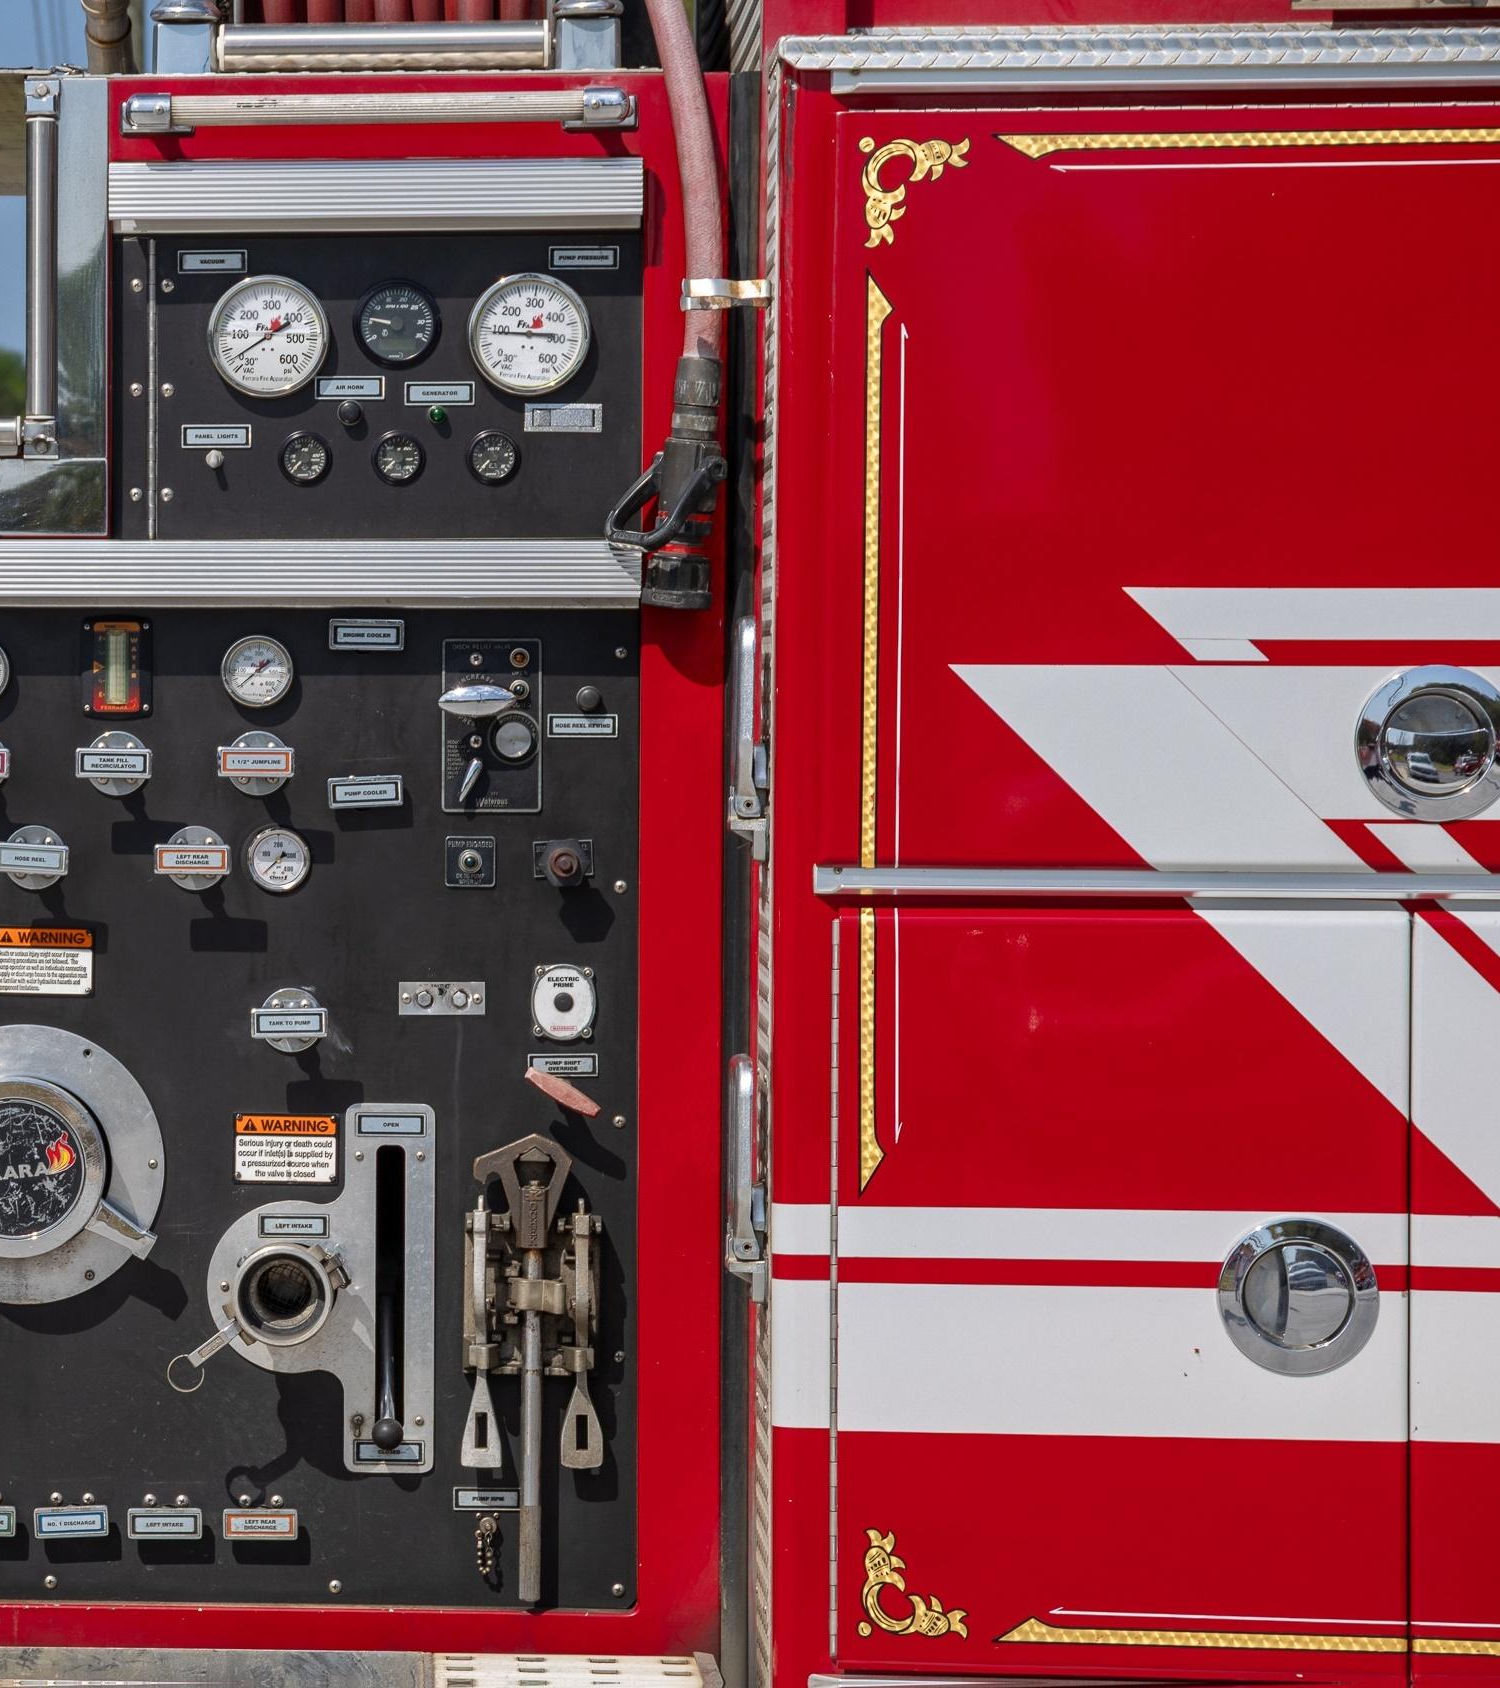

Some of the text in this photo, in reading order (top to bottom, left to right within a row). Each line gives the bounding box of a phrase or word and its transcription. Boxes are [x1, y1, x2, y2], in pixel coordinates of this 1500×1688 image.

[262, 300, 282, 310] 300
[525, 297, 545, 309] 300
[239, 310, 259, 320] 200
[501, 306, 521, 317] 200
[283, 312, 303, 323] 400
[545, 312, 565, 323] 400
[231, 330, 249, 340] 100
[492, 325, 510, 335] 100
[285, 334, 305, 344] 500
[279, 354, 299, 365] 600
[538, 353, 558, 364] 600
[283, 367, 292, 375] psi
[17, 931, 86, 944] WARNING
[260, 1119, 329, 1132] WARNING
[238, 1138, 264, 1147] Serious
[265, 1139, 283, 1149] injury
[293, 1140, 313, 1148] death
[313, 1140, 333, 1148] could
[258, 1149, 264, 1157] if
[264, 1149, 286, 1158] inlet(s)
[286, 1149, 293, 1157] is
[294, 1150, 323, 1159] supplied
[324, 1150, 333, 1160] by
[247, 1159, 286, 1168] pressurized
[311, 1160, 330, 1168] when
[254, 1169, 316, 1178] the valve is closed
